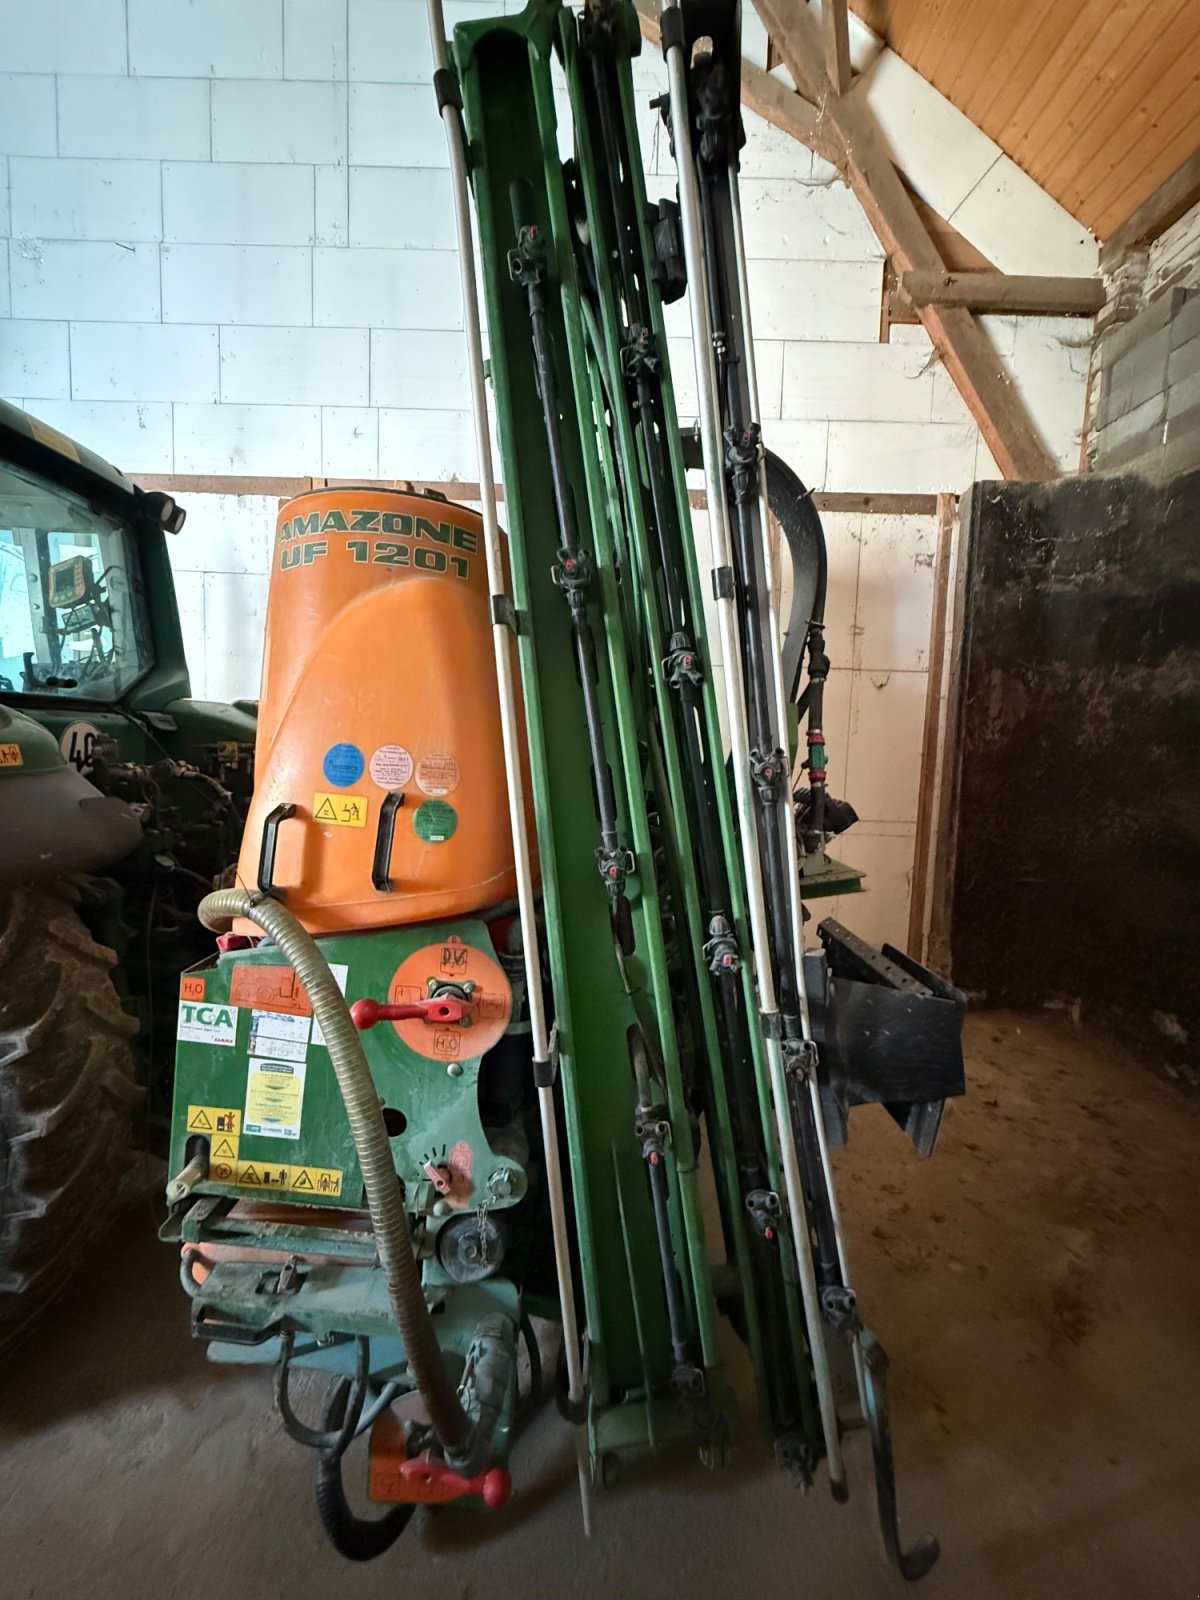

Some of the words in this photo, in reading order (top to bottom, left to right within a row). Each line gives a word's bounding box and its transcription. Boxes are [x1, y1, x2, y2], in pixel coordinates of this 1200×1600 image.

[279, 509, 478, 554] AMAZONE
[280, 540, 328, 572] UF
[346, 539, 470, 580] 1201
[181, 1004, 234, 1029] TCA
